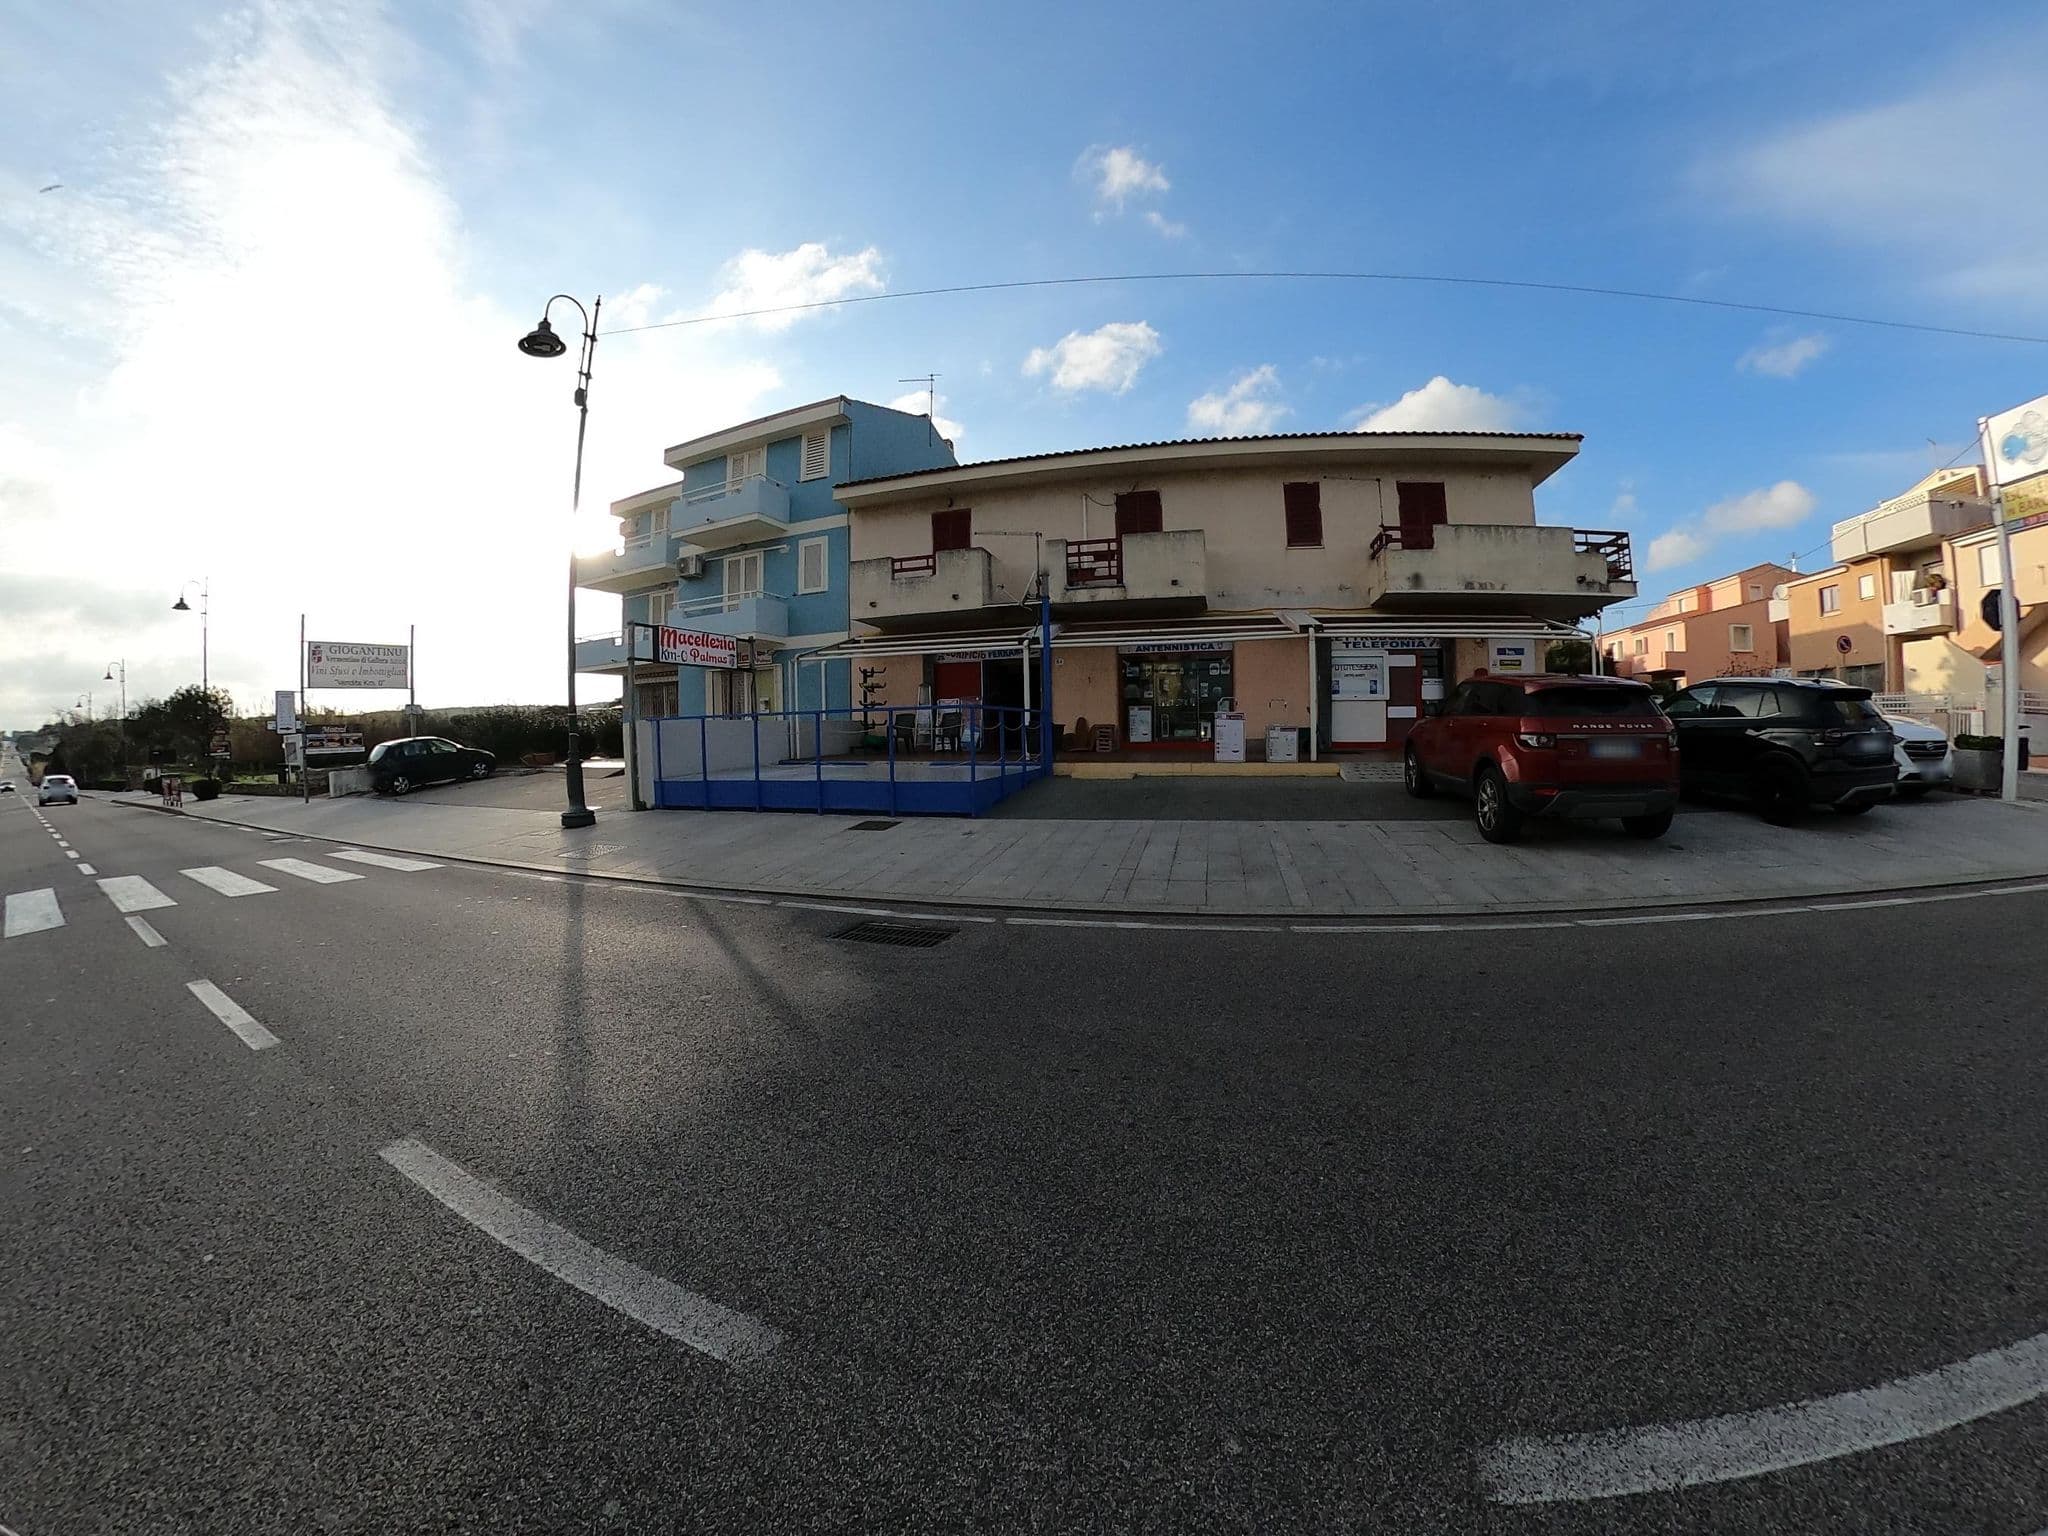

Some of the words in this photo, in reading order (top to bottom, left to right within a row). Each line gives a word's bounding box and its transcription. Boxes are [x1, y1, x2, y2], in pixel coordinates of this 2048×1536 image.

[660, 627, 735, 651] Macelleria
[1342, 641, 1426, 649] TELEFONIA
[329, 645, 402, 657] GIOGANTINU
[1135, 643, 1215, 652] ANTENNISTICA
[689, 648, 727, 664] Palmas
